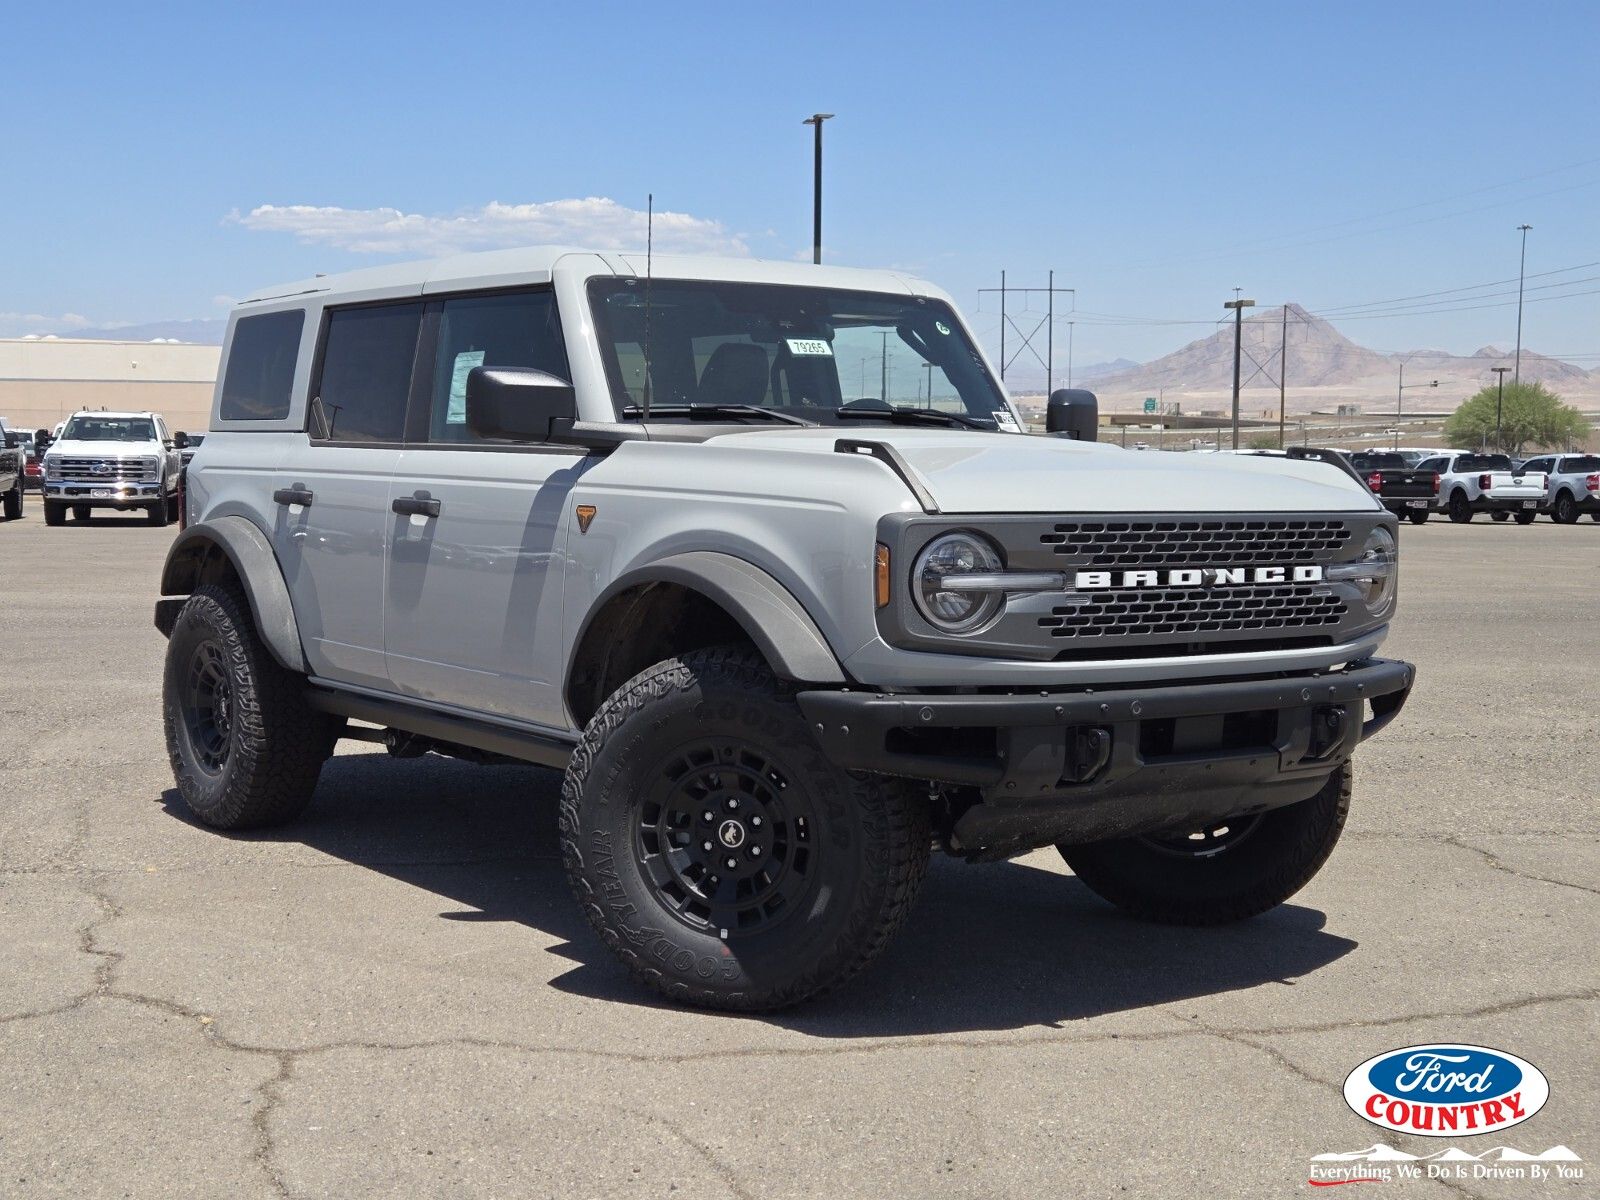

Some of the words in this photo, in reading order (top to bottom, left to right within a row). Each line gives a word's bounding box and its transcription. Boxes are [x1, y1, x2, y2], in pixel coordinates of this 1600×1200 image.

[793, 341, 825, 353] 79265
[1075, 565, 1322, 589] BRONCO
[591, 828, 742, 983] GOODYEAR
